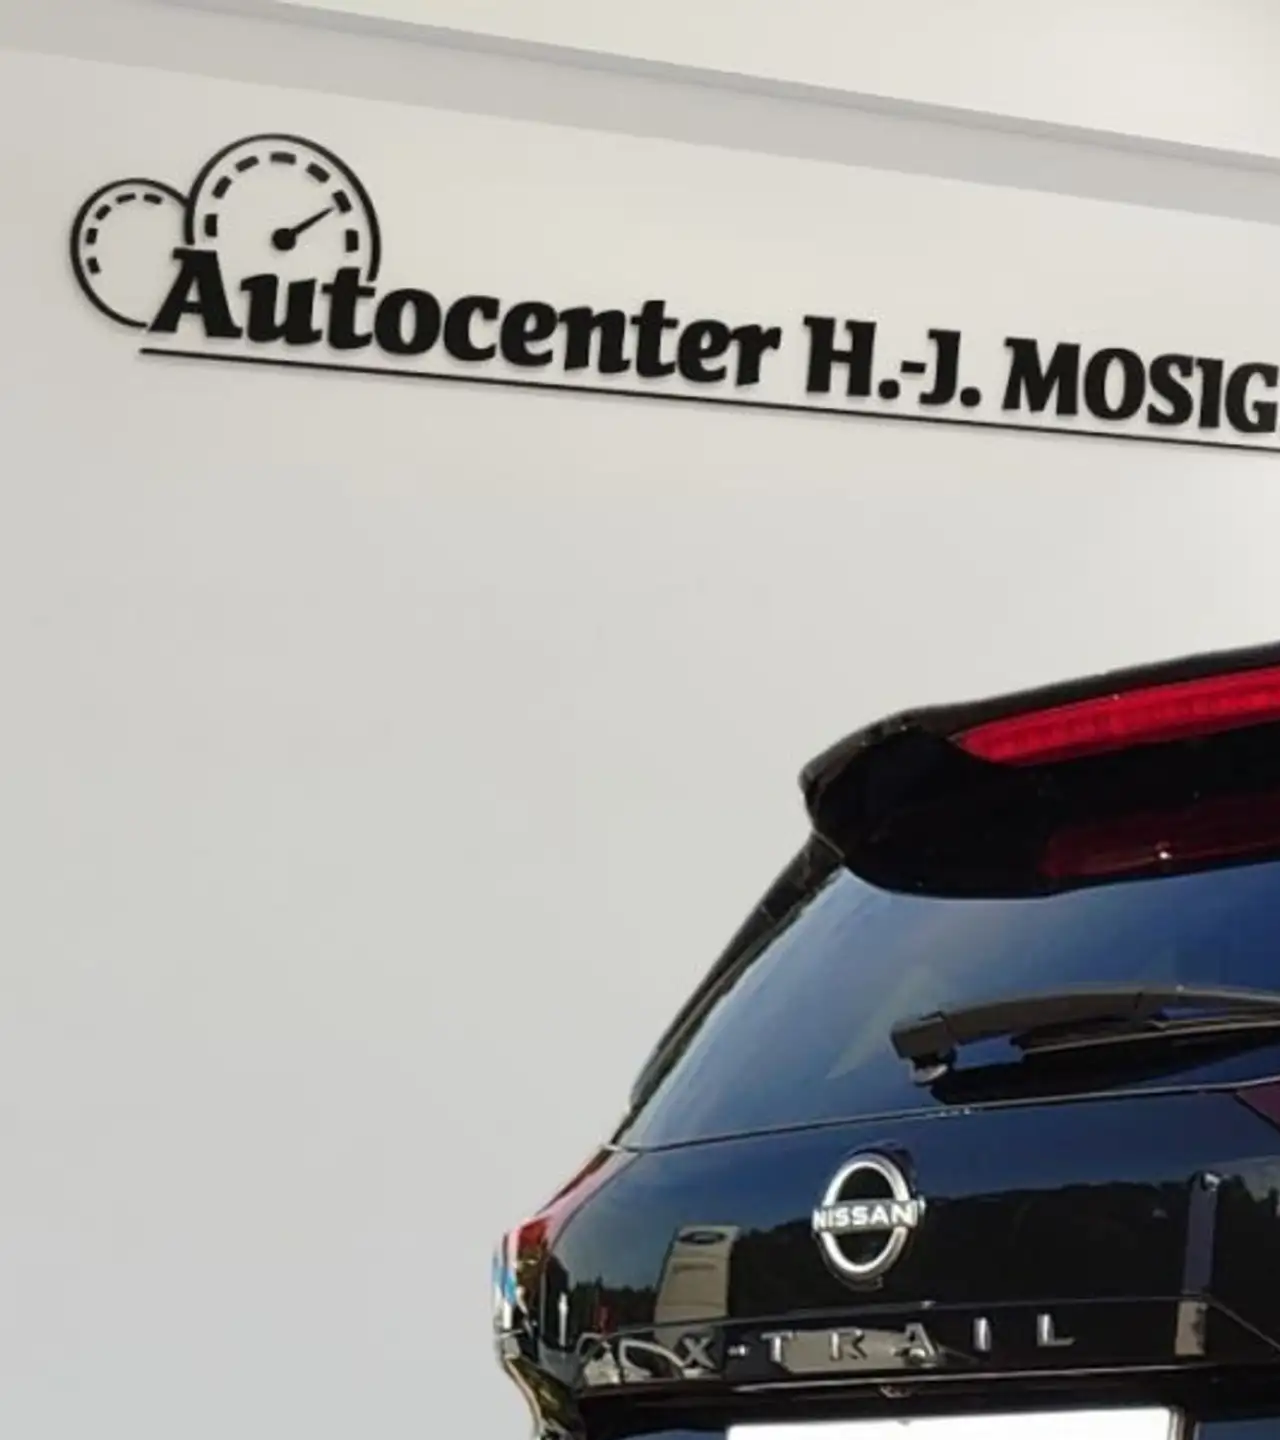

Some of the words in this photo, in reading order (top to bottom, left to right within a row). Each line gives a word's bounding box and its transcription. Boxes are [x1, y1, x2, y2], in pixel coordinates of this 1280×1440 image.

[149, 248, 781, 386] Autocenter
[804, 316, 980, 407] H.-J.
[812, 1202, 918, 1231] NISSAN
[680, 1312, 1077, 1369] X-TRAIL
